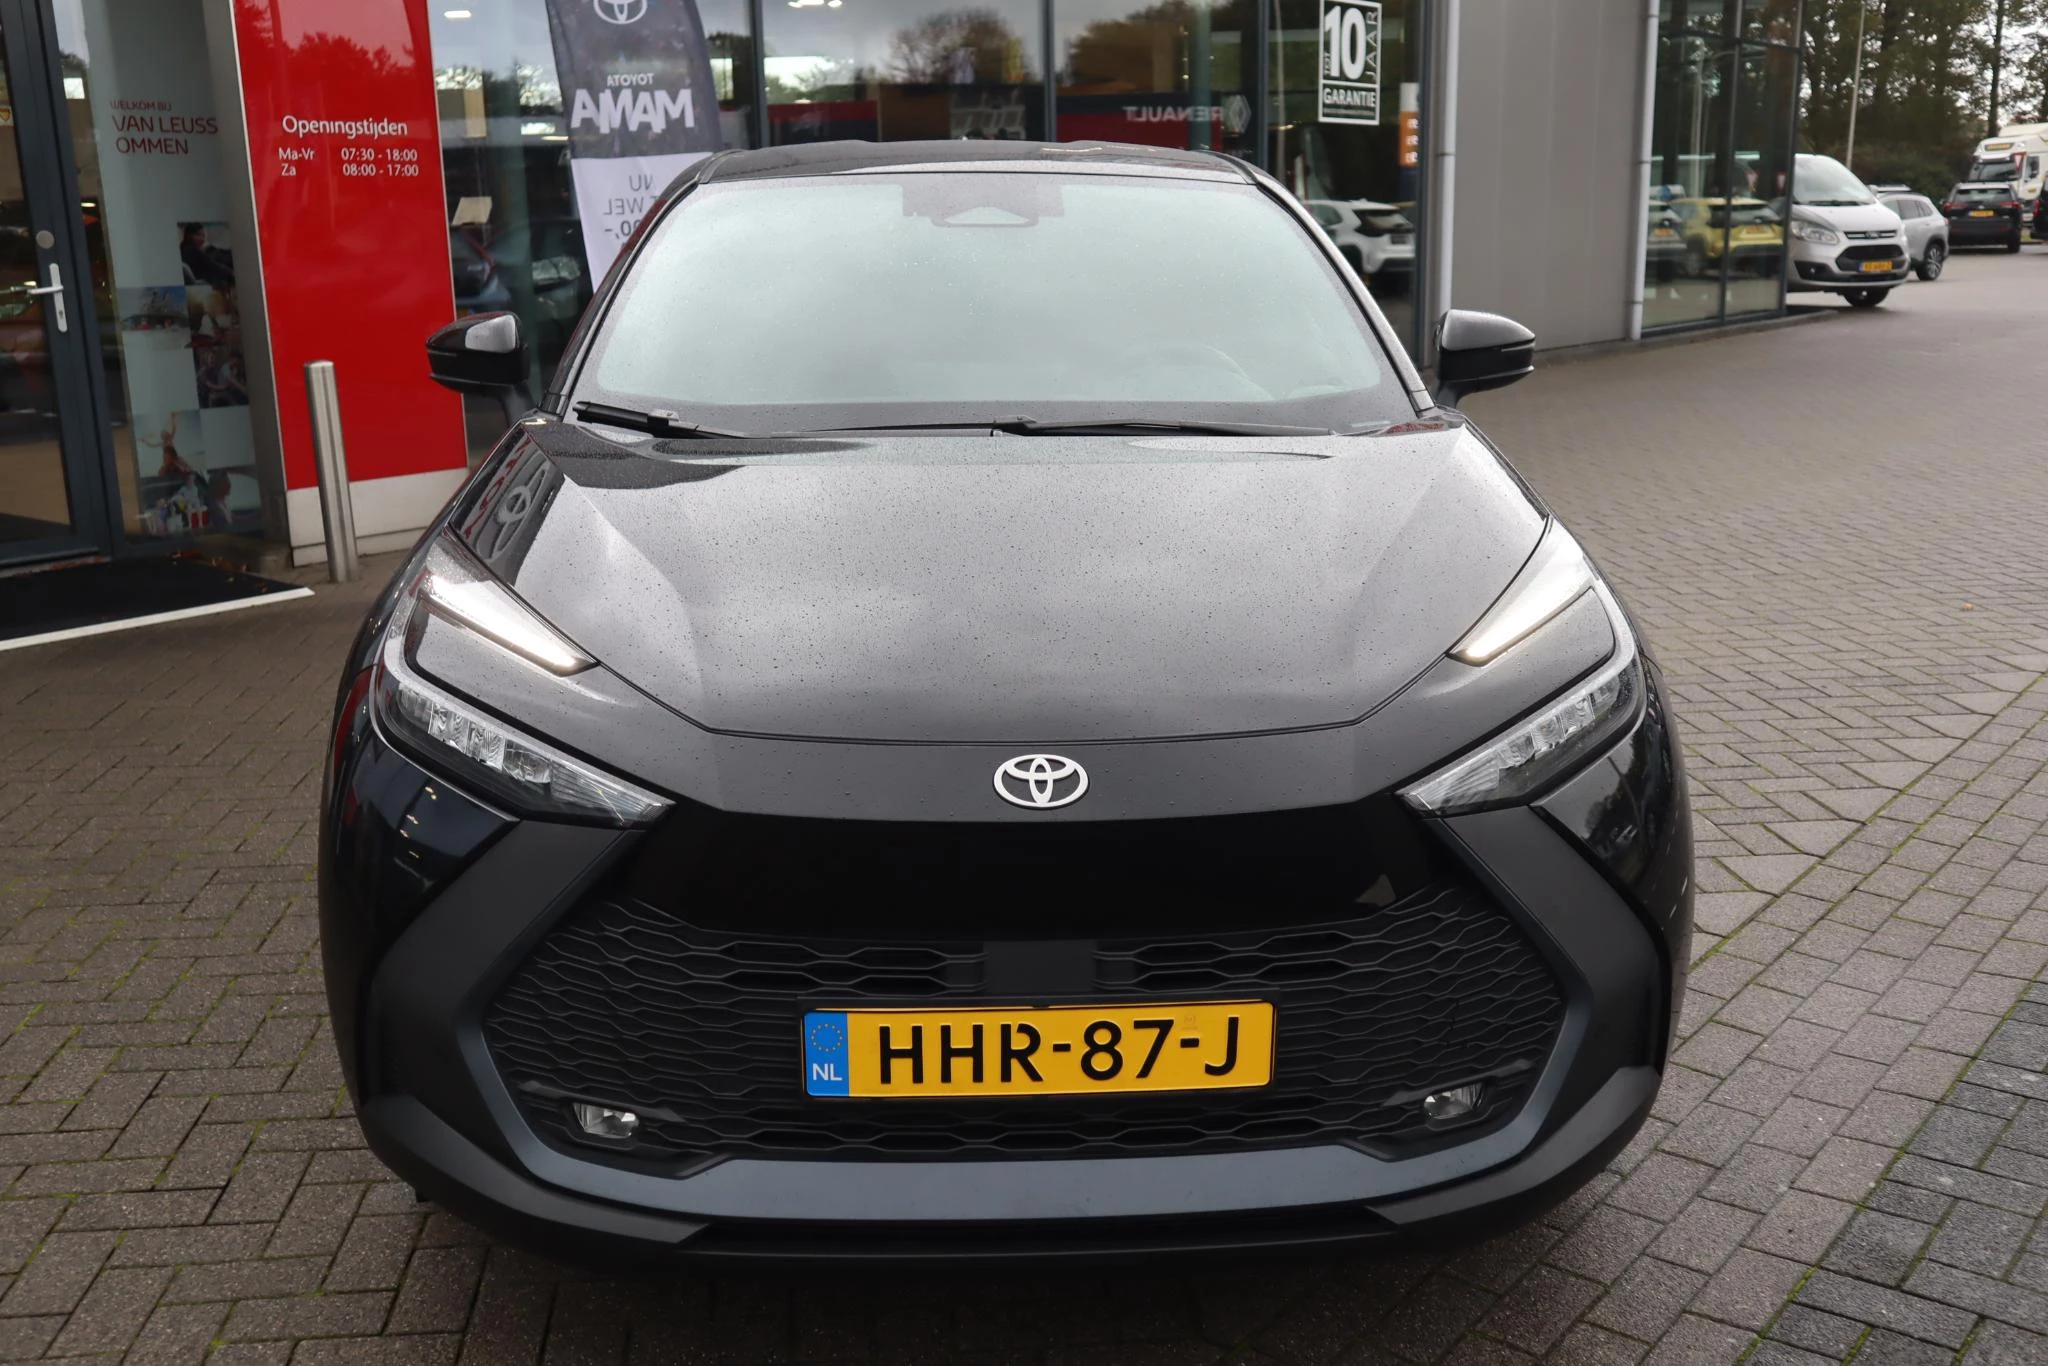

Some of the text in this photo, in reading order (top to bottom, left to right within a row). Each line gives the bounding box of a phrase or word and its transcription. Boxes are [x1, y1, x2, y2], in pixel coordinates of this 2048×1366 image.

[1325, 5, 1367, 80] 10
[1365, 11, 1378, 80] JAAR
[111, 100, 156, 112] WELKOM
[1323, 87, 1376, 107] GARANTIE
[112, 115, 219, 135] VAN LEUSS
[282, 115, 408, 140] Openingstijden
[116, 137, 189, 154] OMMEN
[278, 147, 315, 160] Ma-Vr
[341, 147, 374, 161] 07:30
[386, 149, 418, 161] 18:00
[281, 163, 297, 176] Za
[342, 164, 376, 176] 08:00
[387, 165, 419, 177] 17:00
[879, 1016, 1240, 1085] HHR-87-J
[812, 1063, 843, 1081] NL
